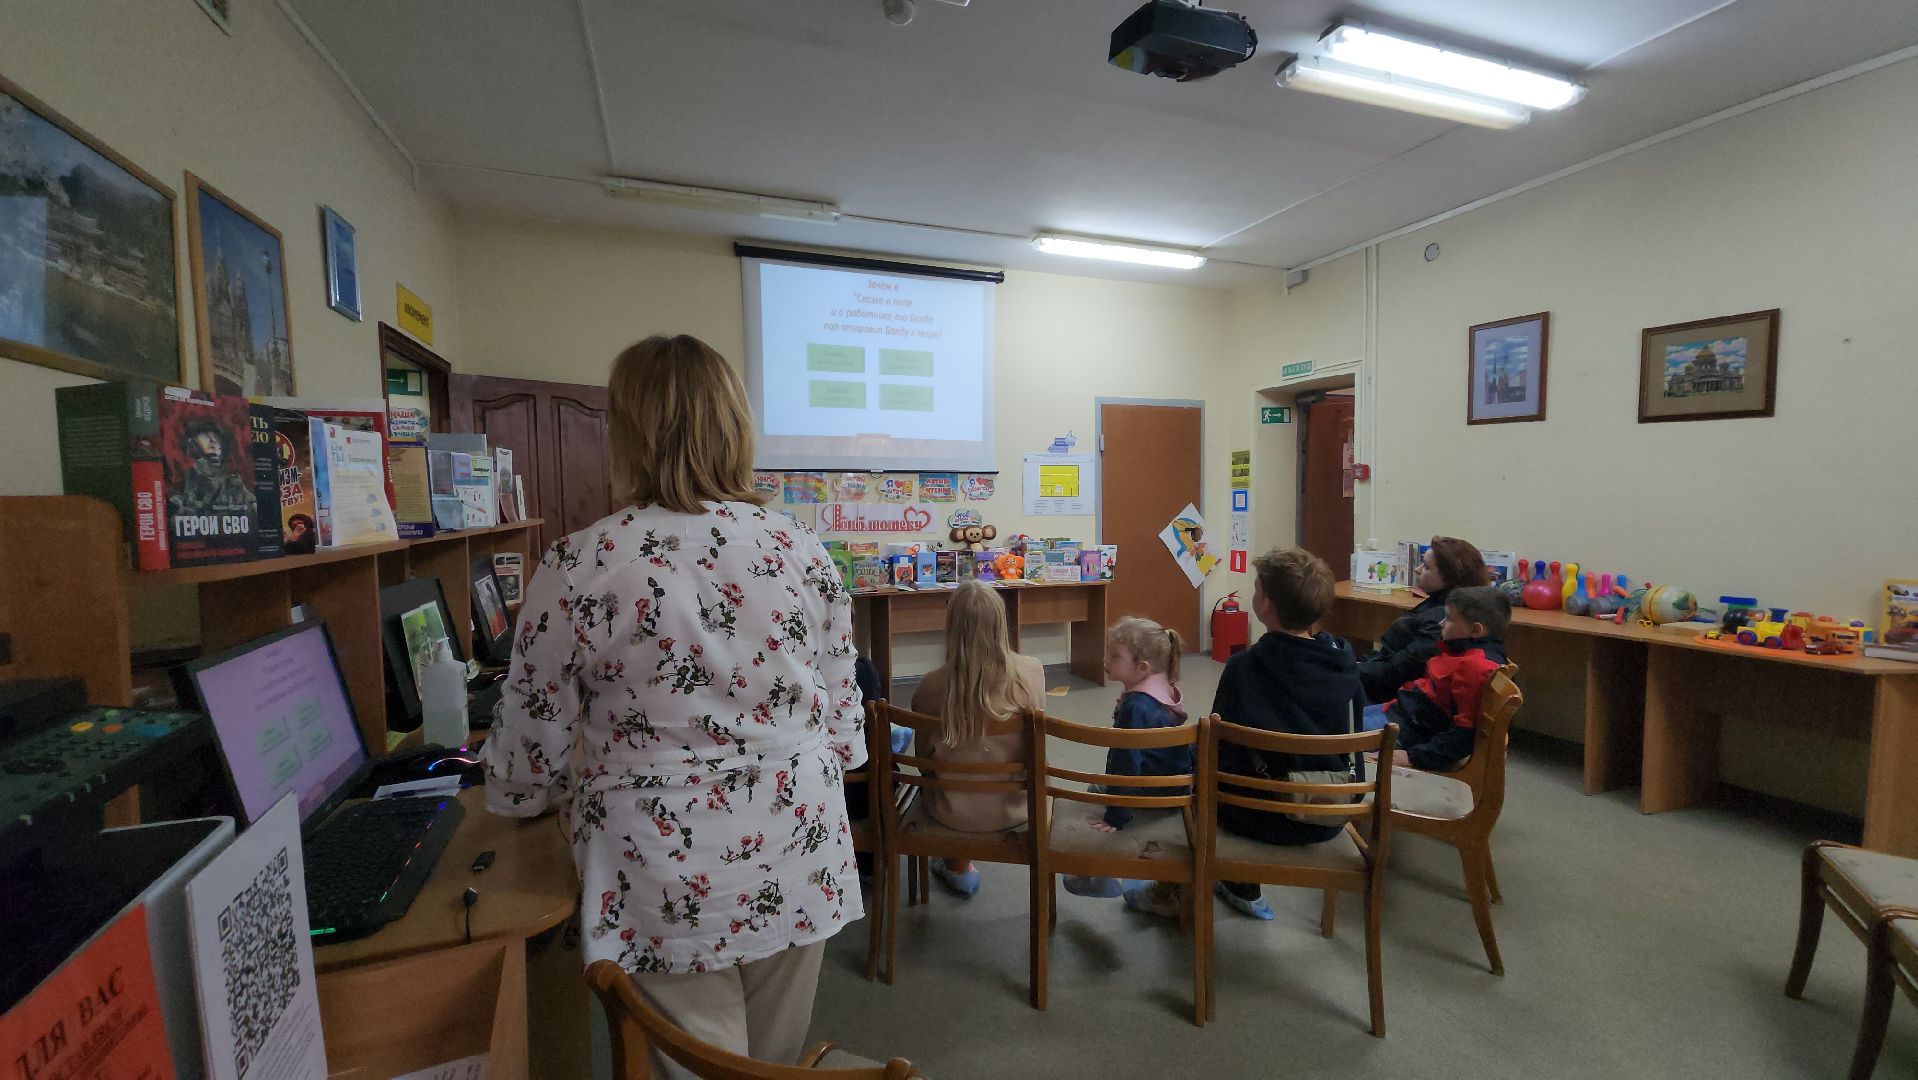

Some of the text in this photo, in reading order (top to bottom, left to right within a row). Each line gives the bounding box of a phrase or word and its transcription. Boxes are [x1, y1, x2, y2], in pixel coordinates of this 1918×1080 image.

[893, 298, 913, 307] попе
[846, 308, 892, 320] работнике
[823, 321, 839, 333] поп
[841, 325, 883, 336] отправил
[136, 490, 156, 541] ГЕРОИ СВО
[175, 514, 250, 537] ГЕРОИ СВО
